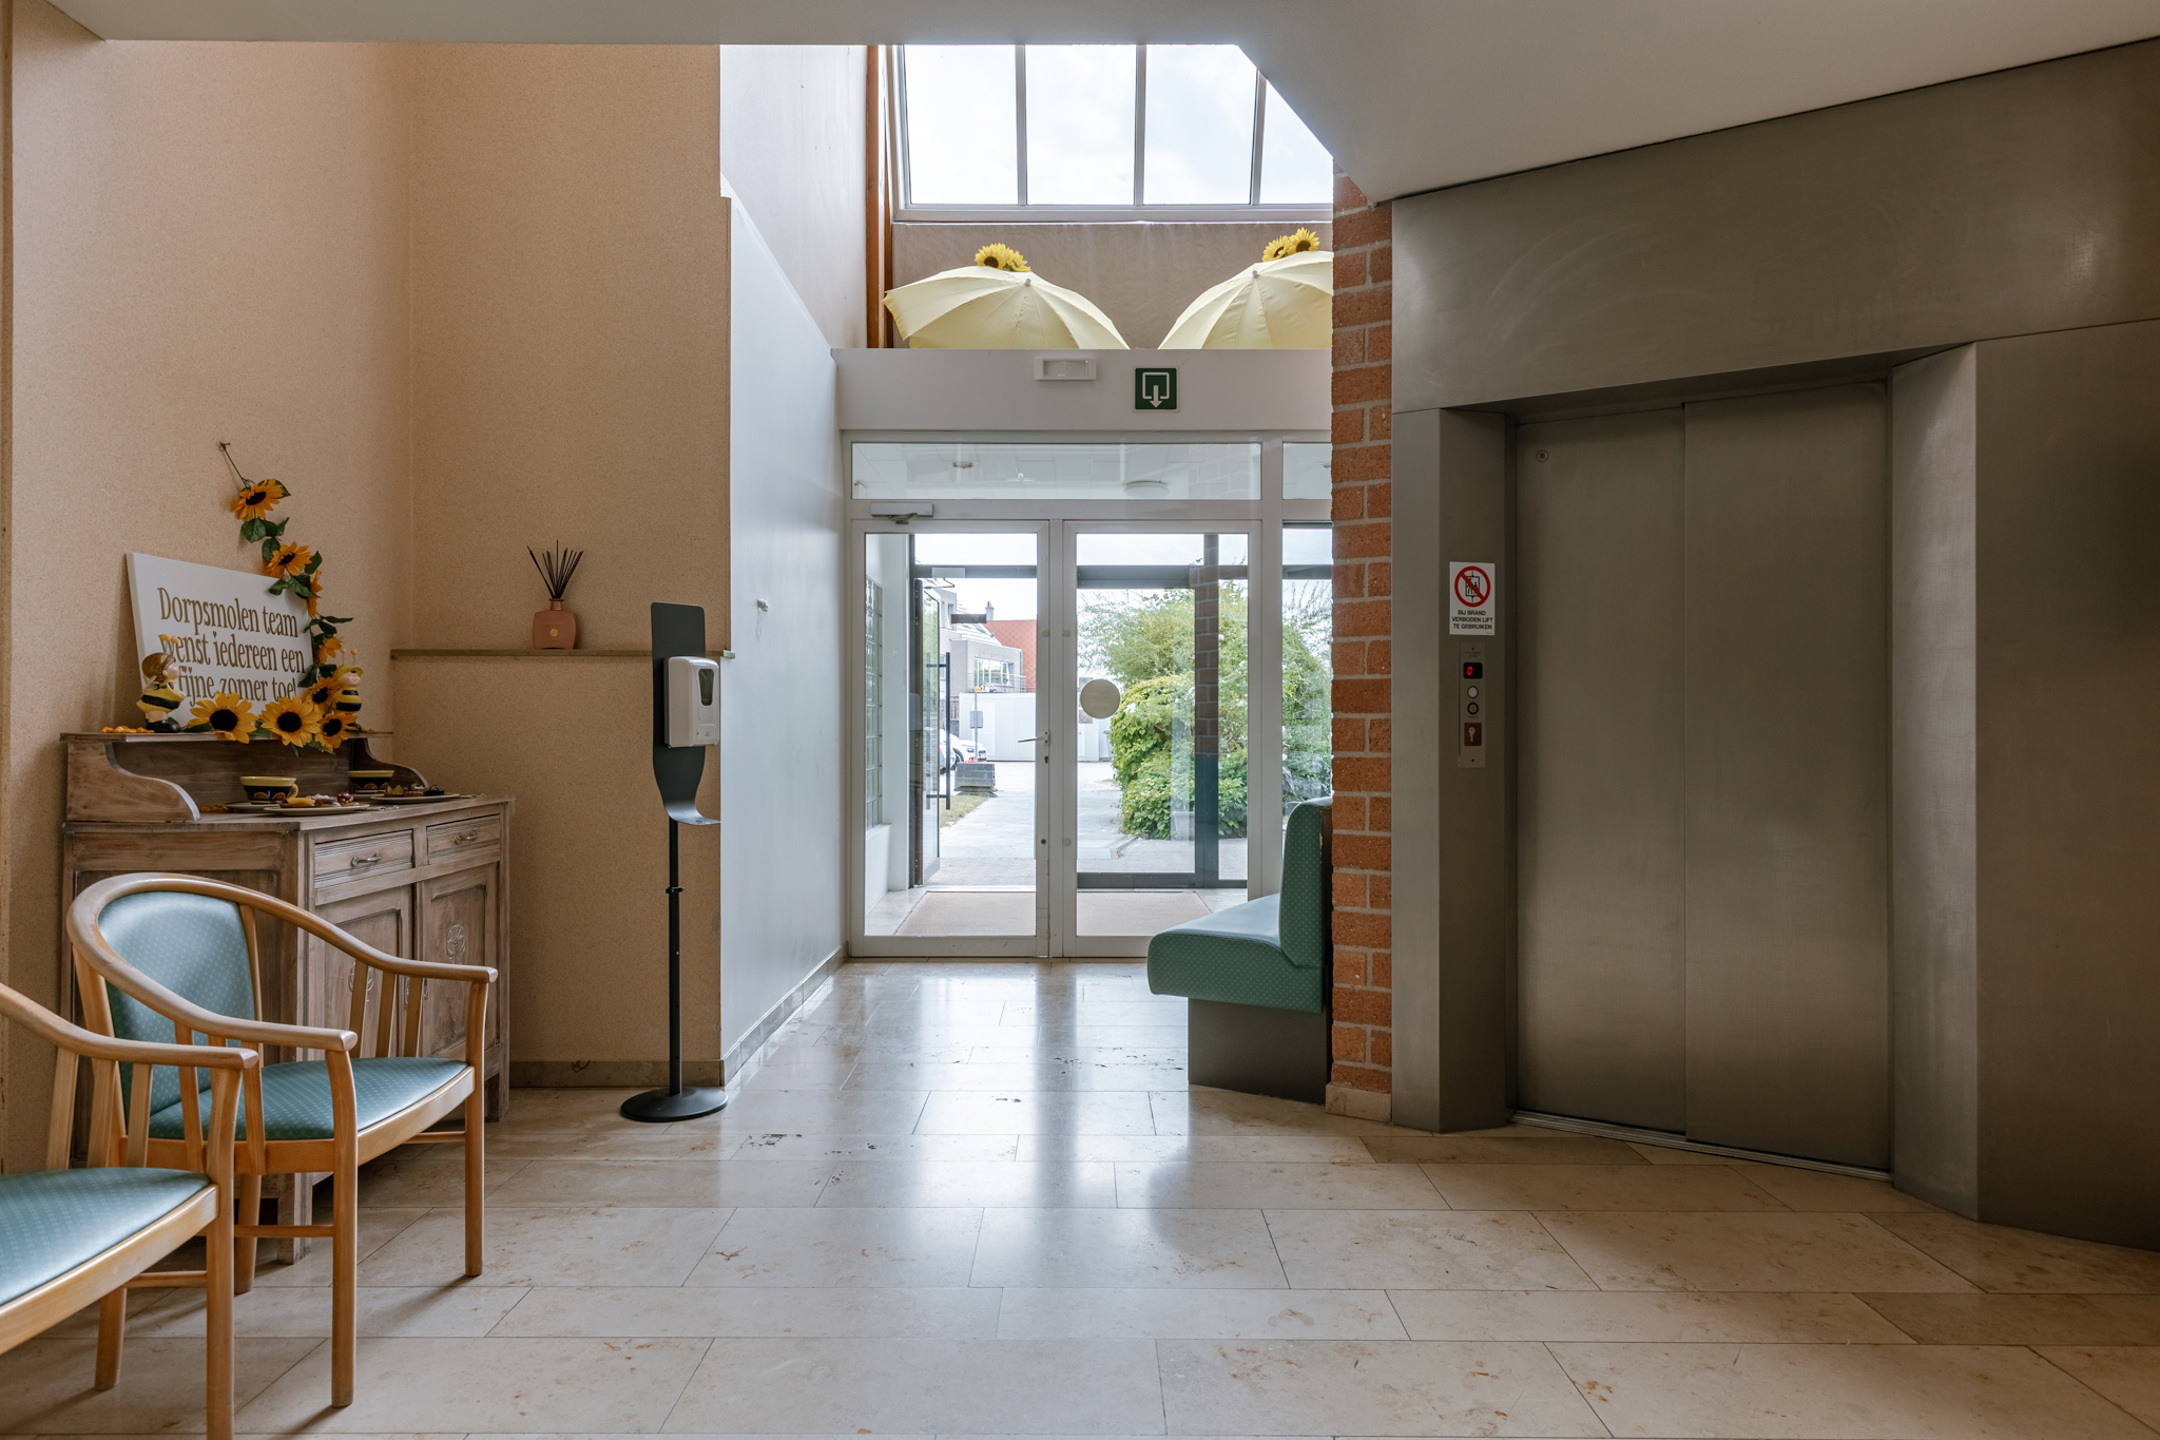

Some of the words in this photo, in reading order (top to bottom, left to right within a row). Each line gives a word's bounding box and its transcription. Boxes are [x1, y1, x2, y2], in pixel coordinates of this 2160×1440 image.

[157, 587, 260, 635] Dorpsmolen
[262, 605, 299, 638] team
[212, 630, 278, 671] iedereen
[281, 648, 306, 674] een
[219, 677, 269, 702] zomer
